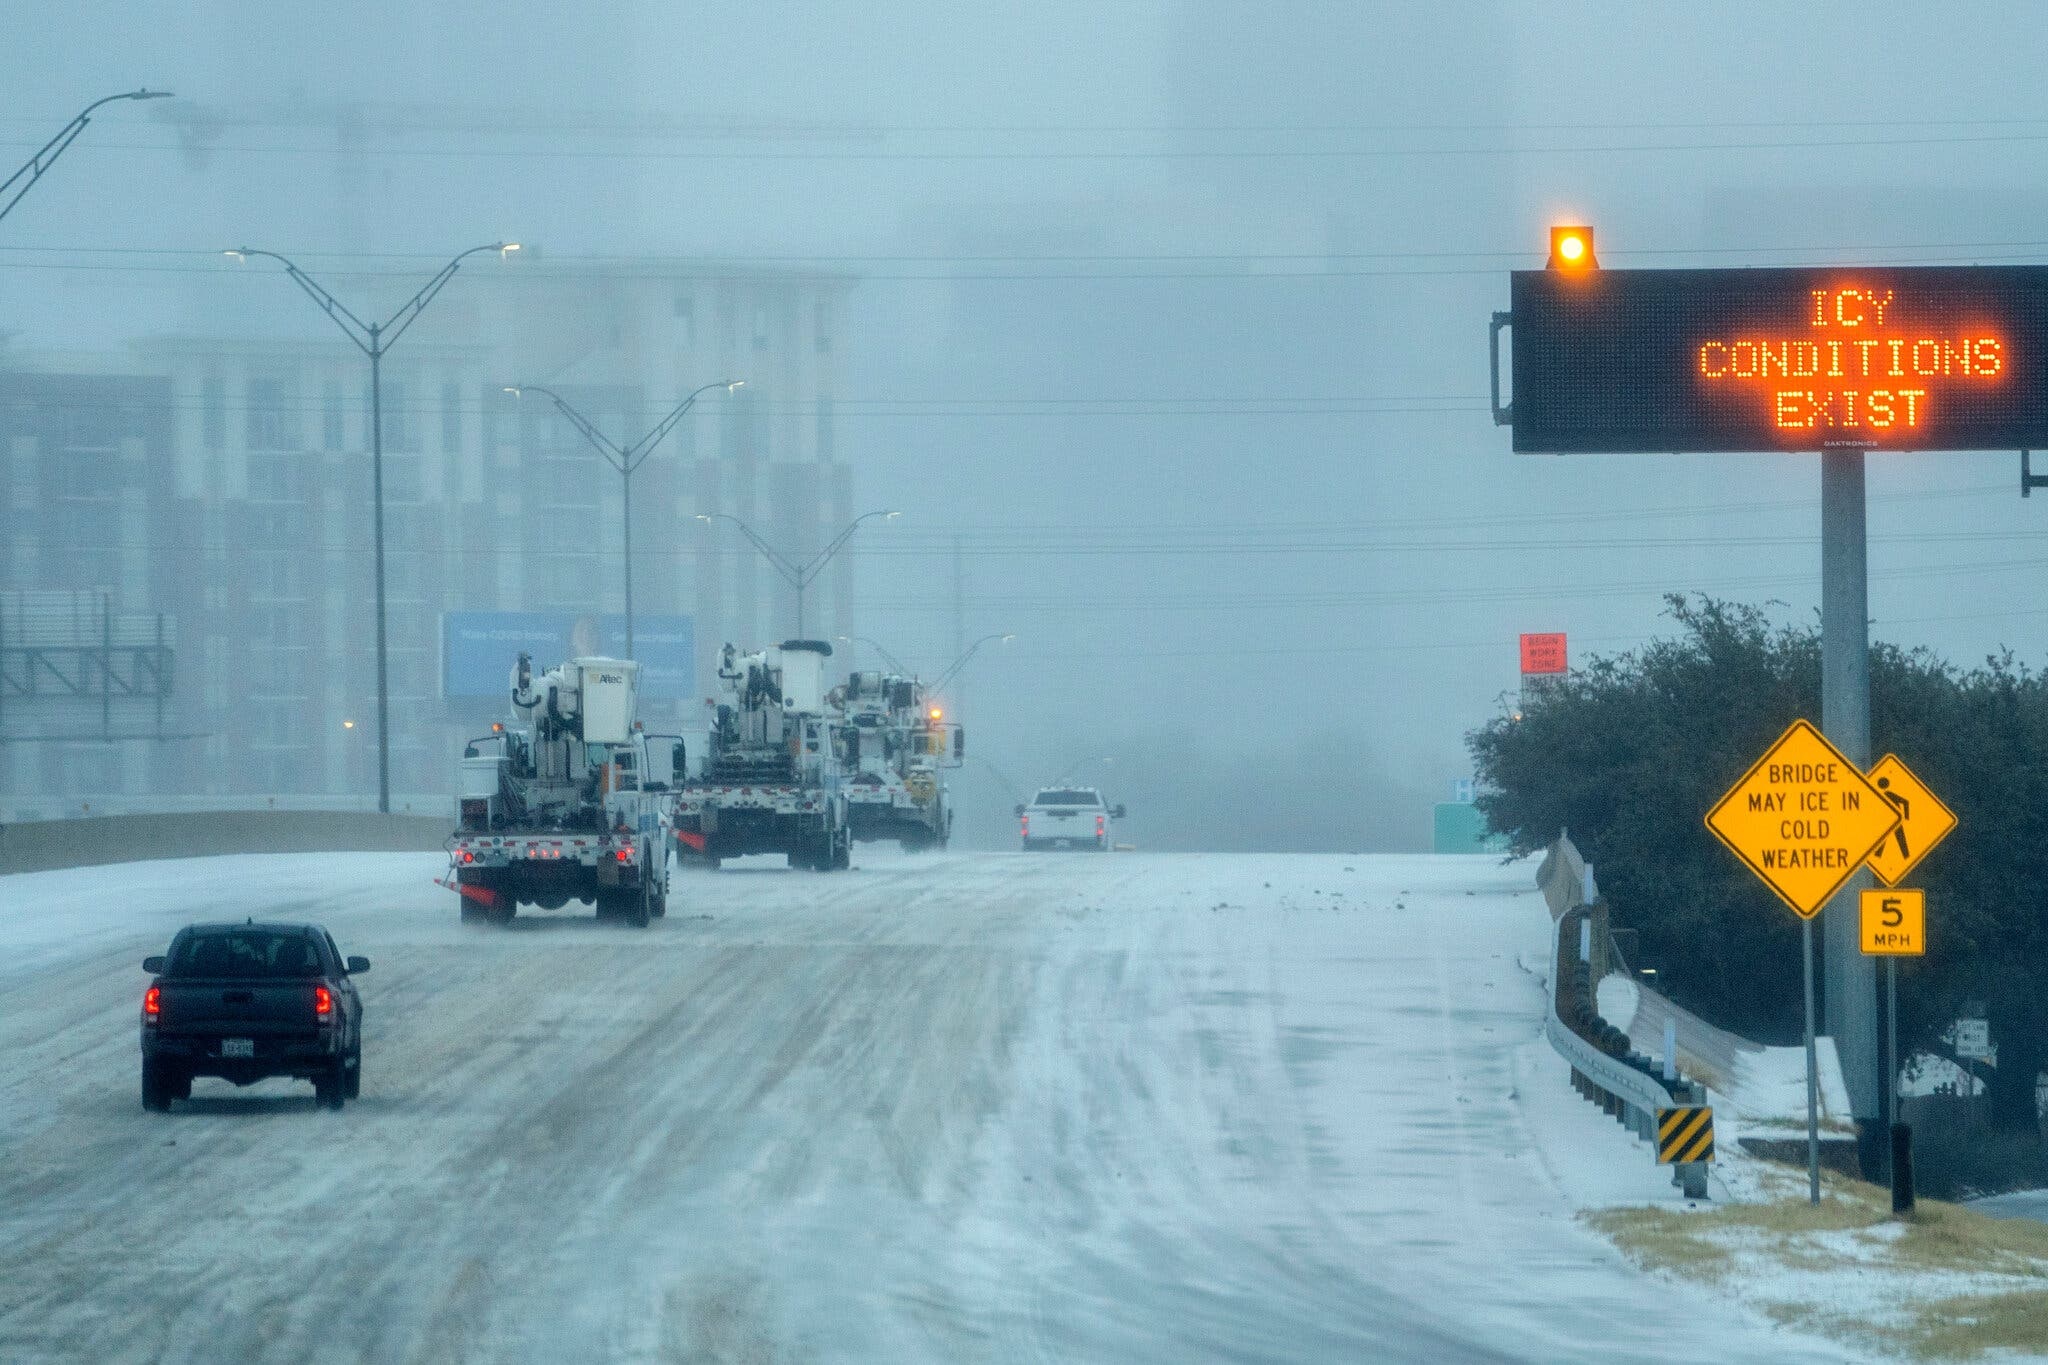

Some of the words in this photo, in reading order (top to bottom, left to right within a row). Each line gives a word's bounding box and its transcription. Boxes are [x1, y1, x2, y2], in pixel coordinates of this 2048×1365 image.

[1811, 289, 1894, 328] ICY
[1699, 337, 2002, 379] CONDITIONS
[1776, 388, 1926, 428] EXIST
[1529, 647, 1557, 657] WORK
[1532, 659, 1556, 668] ZONE
[600, 674, 623, 684] Altec
[1769, 763, 1838, 784] BRIDGE
[1748, 791, 1787, 812] MAY
[1800, 792, 1829, 811] ICE
[1842, 791, 1860, 811] IN
[1780, 819, 1830, 840] COLD
[1762, 848, 1849, 869] WEATHER
[1881, 898, 1903, 928] 5
[1874, 934, 1910, 947] MPH
